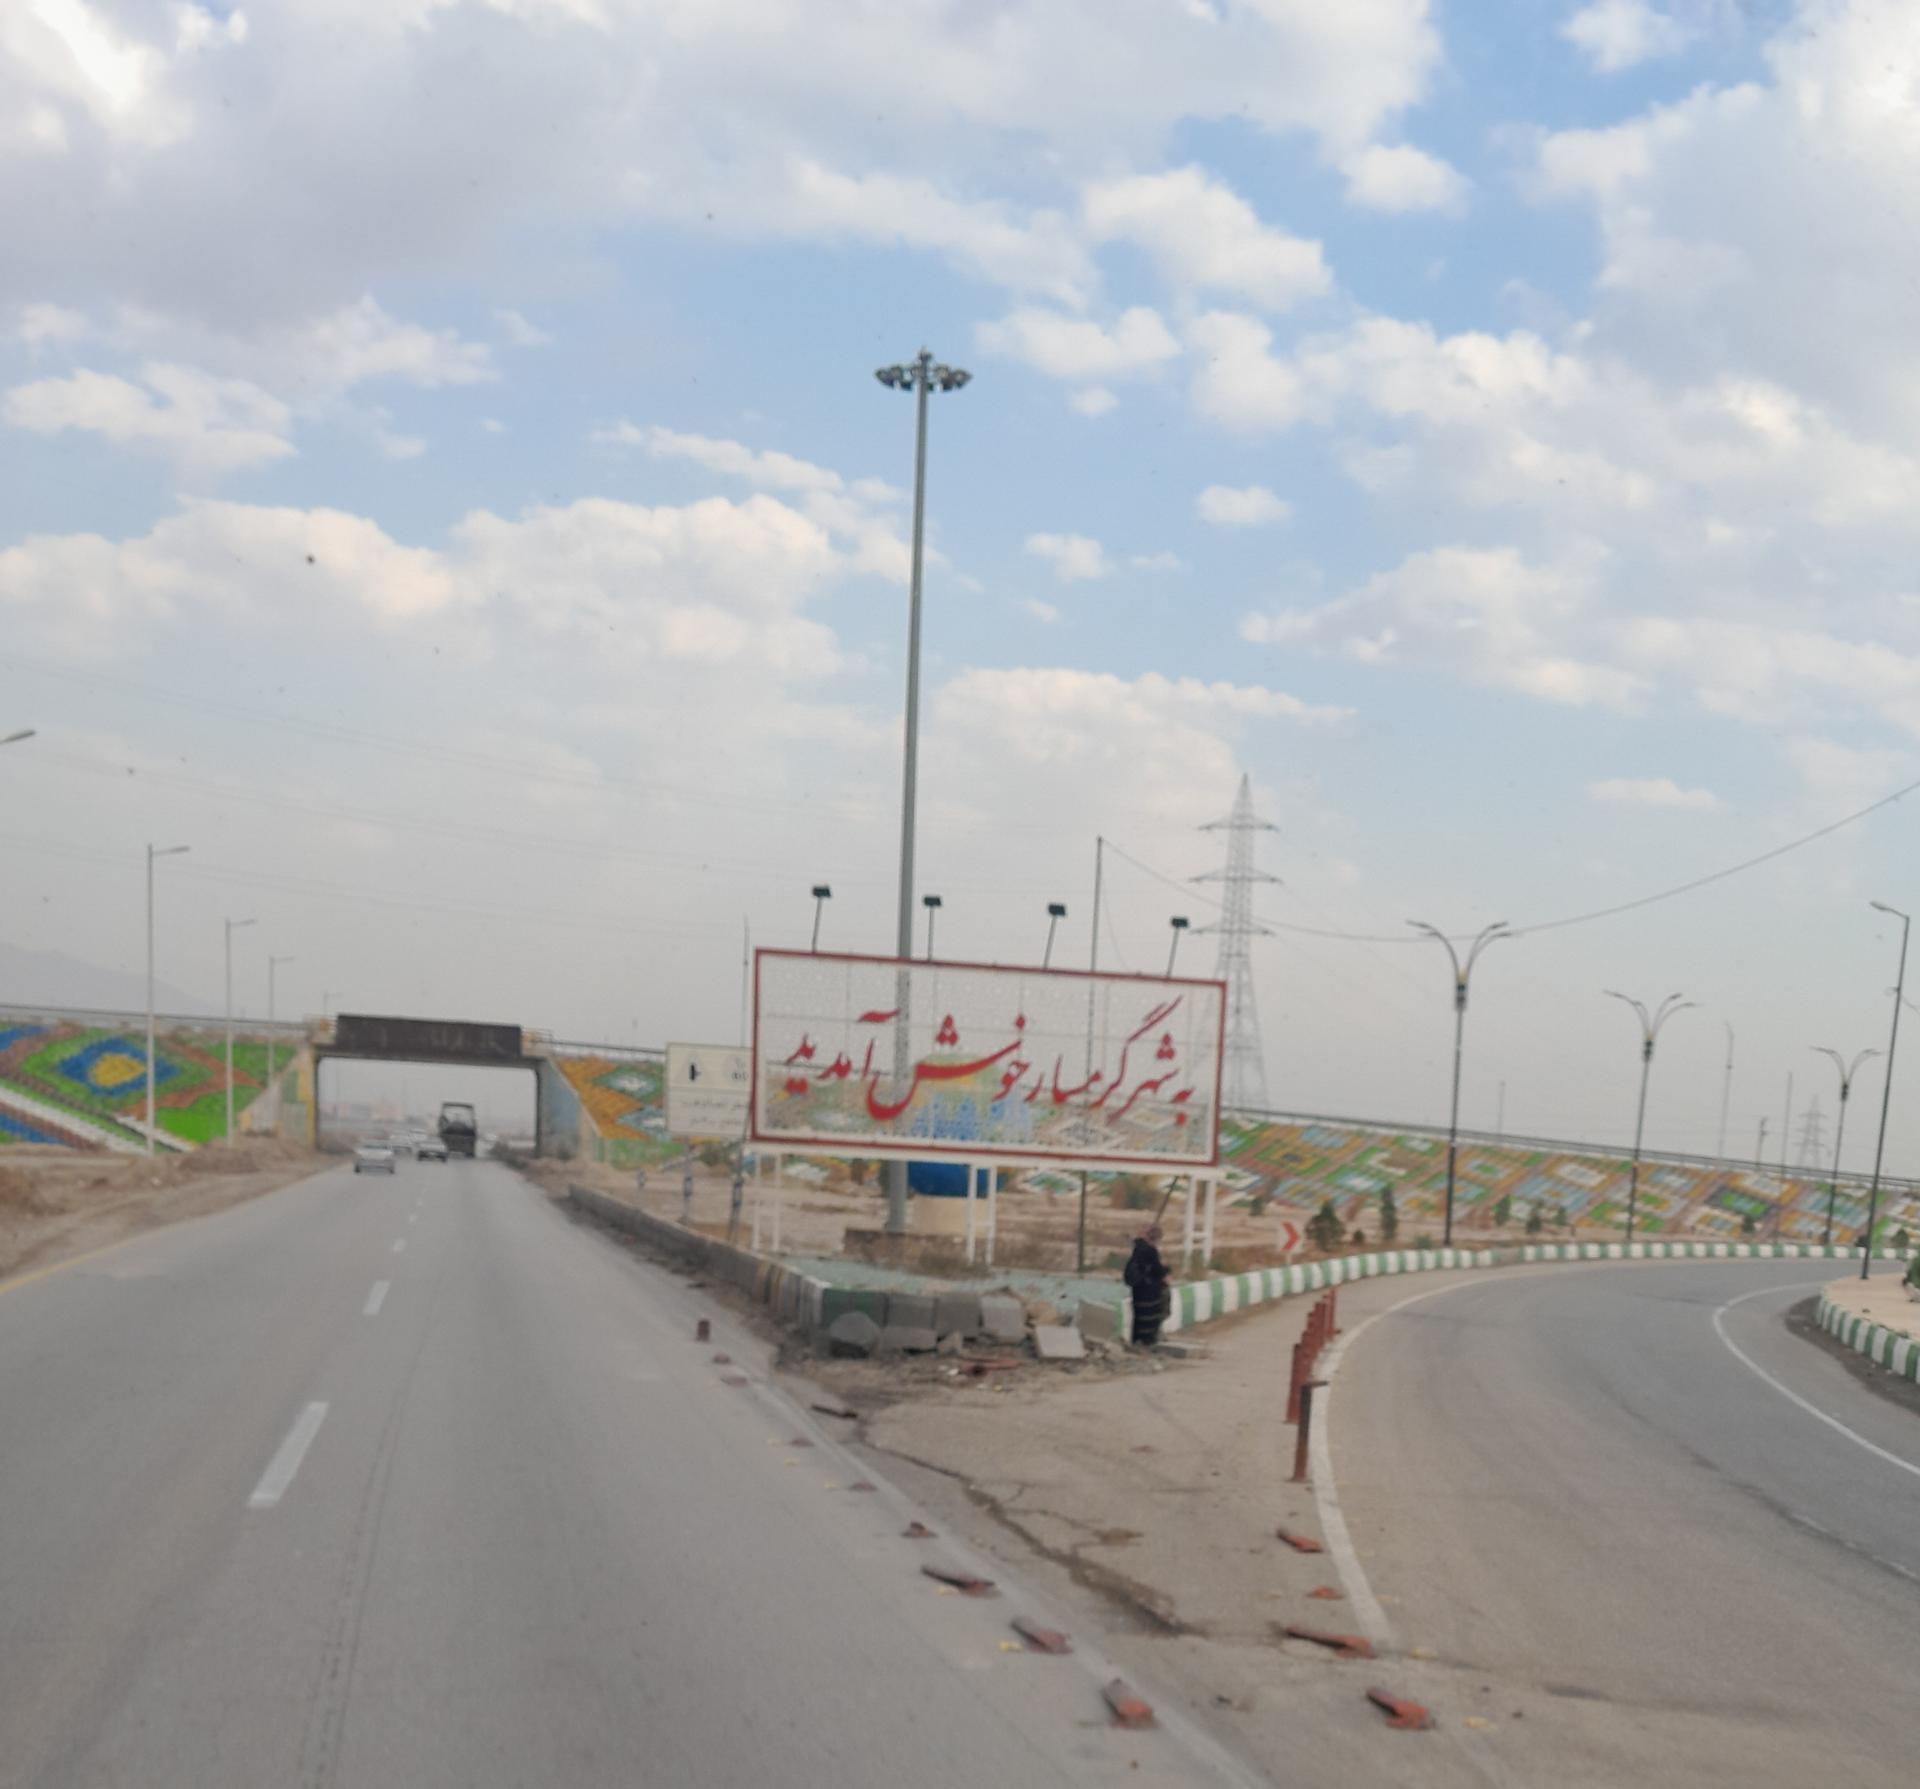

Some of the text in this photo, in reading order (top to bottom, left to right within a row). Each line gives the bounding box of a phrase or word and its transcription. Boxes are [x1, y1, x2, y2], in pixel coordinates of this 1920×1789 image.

[785, 995, 1195, 1126] به شهر گرمسار خوش آمدید
